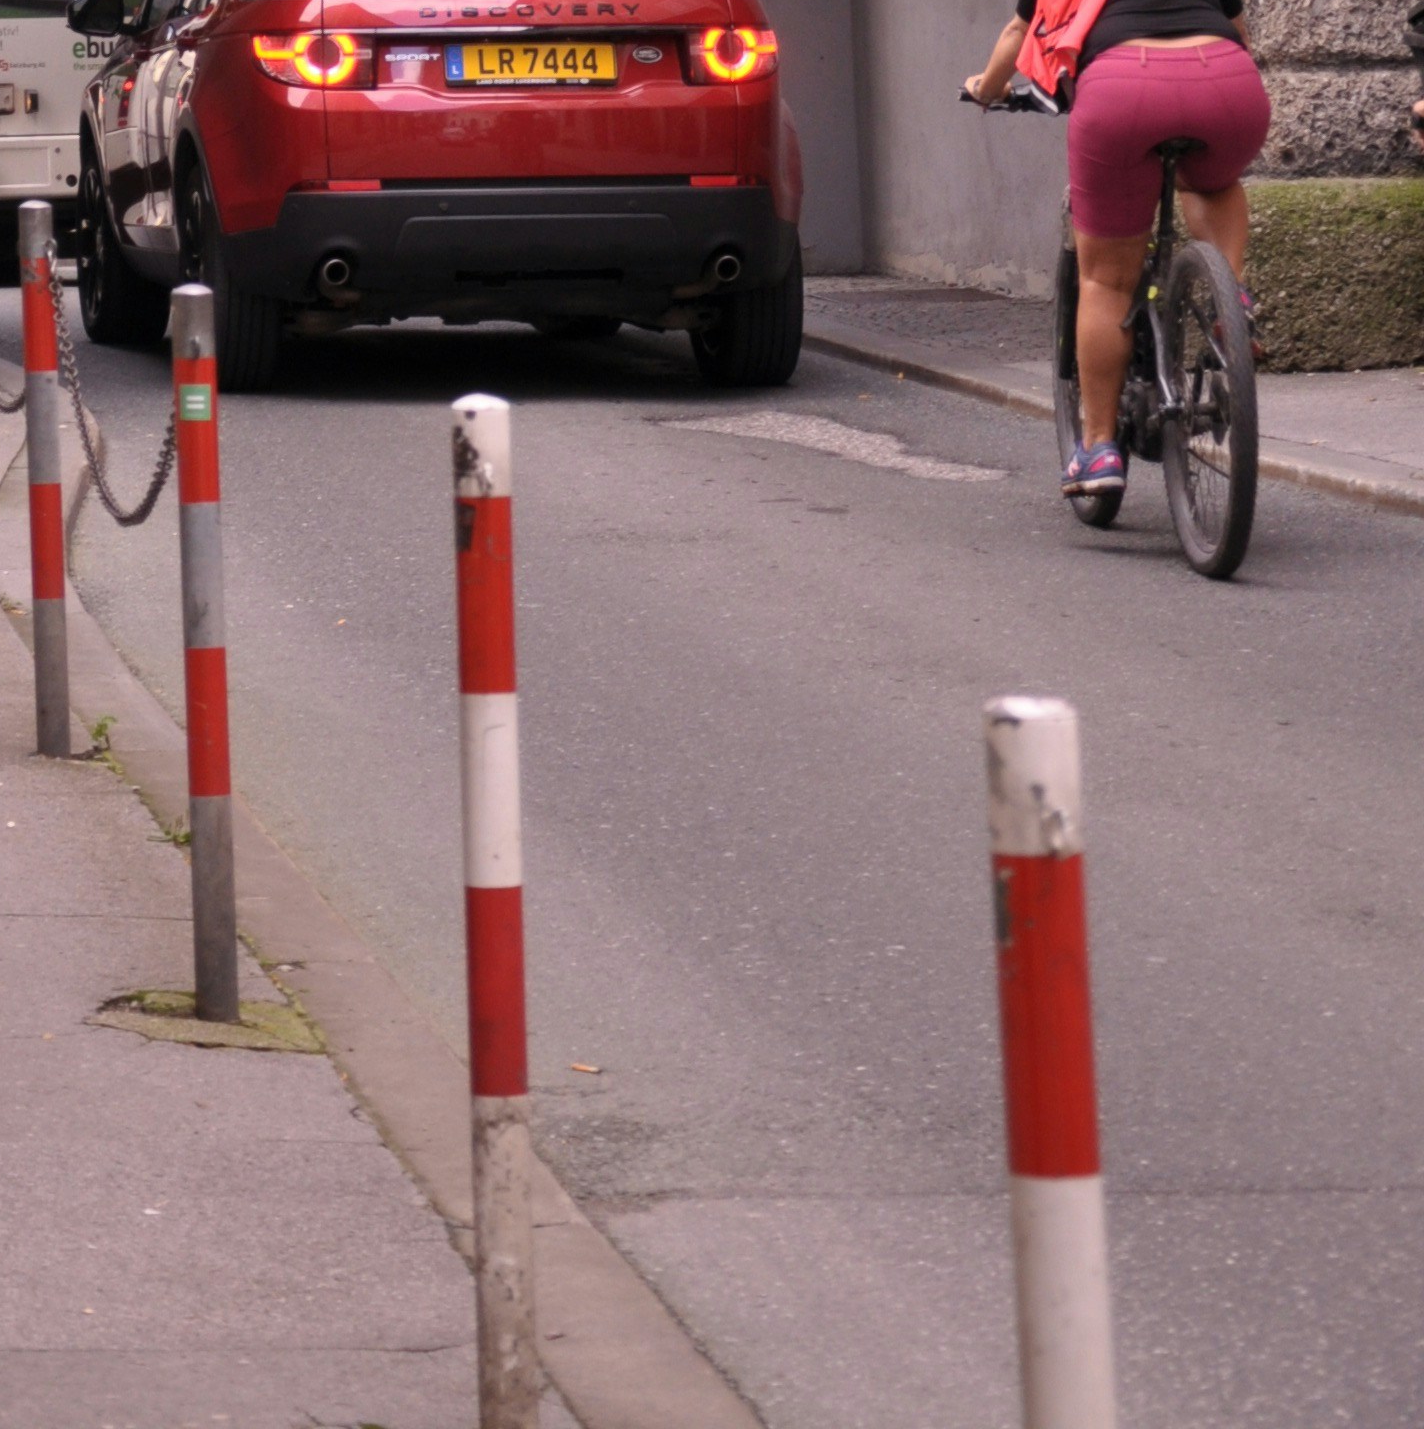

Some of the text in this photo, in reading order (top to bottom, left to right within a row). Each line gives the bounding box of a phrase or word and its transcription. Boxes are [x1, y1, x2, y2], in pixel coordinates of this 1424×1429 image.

[419, 3, 640, 18] DISCOVERY
[385, 53, 441, 62] SPORT
[478, 47, 598, 74] LR 7444
[451, 65, 460, 75] L
